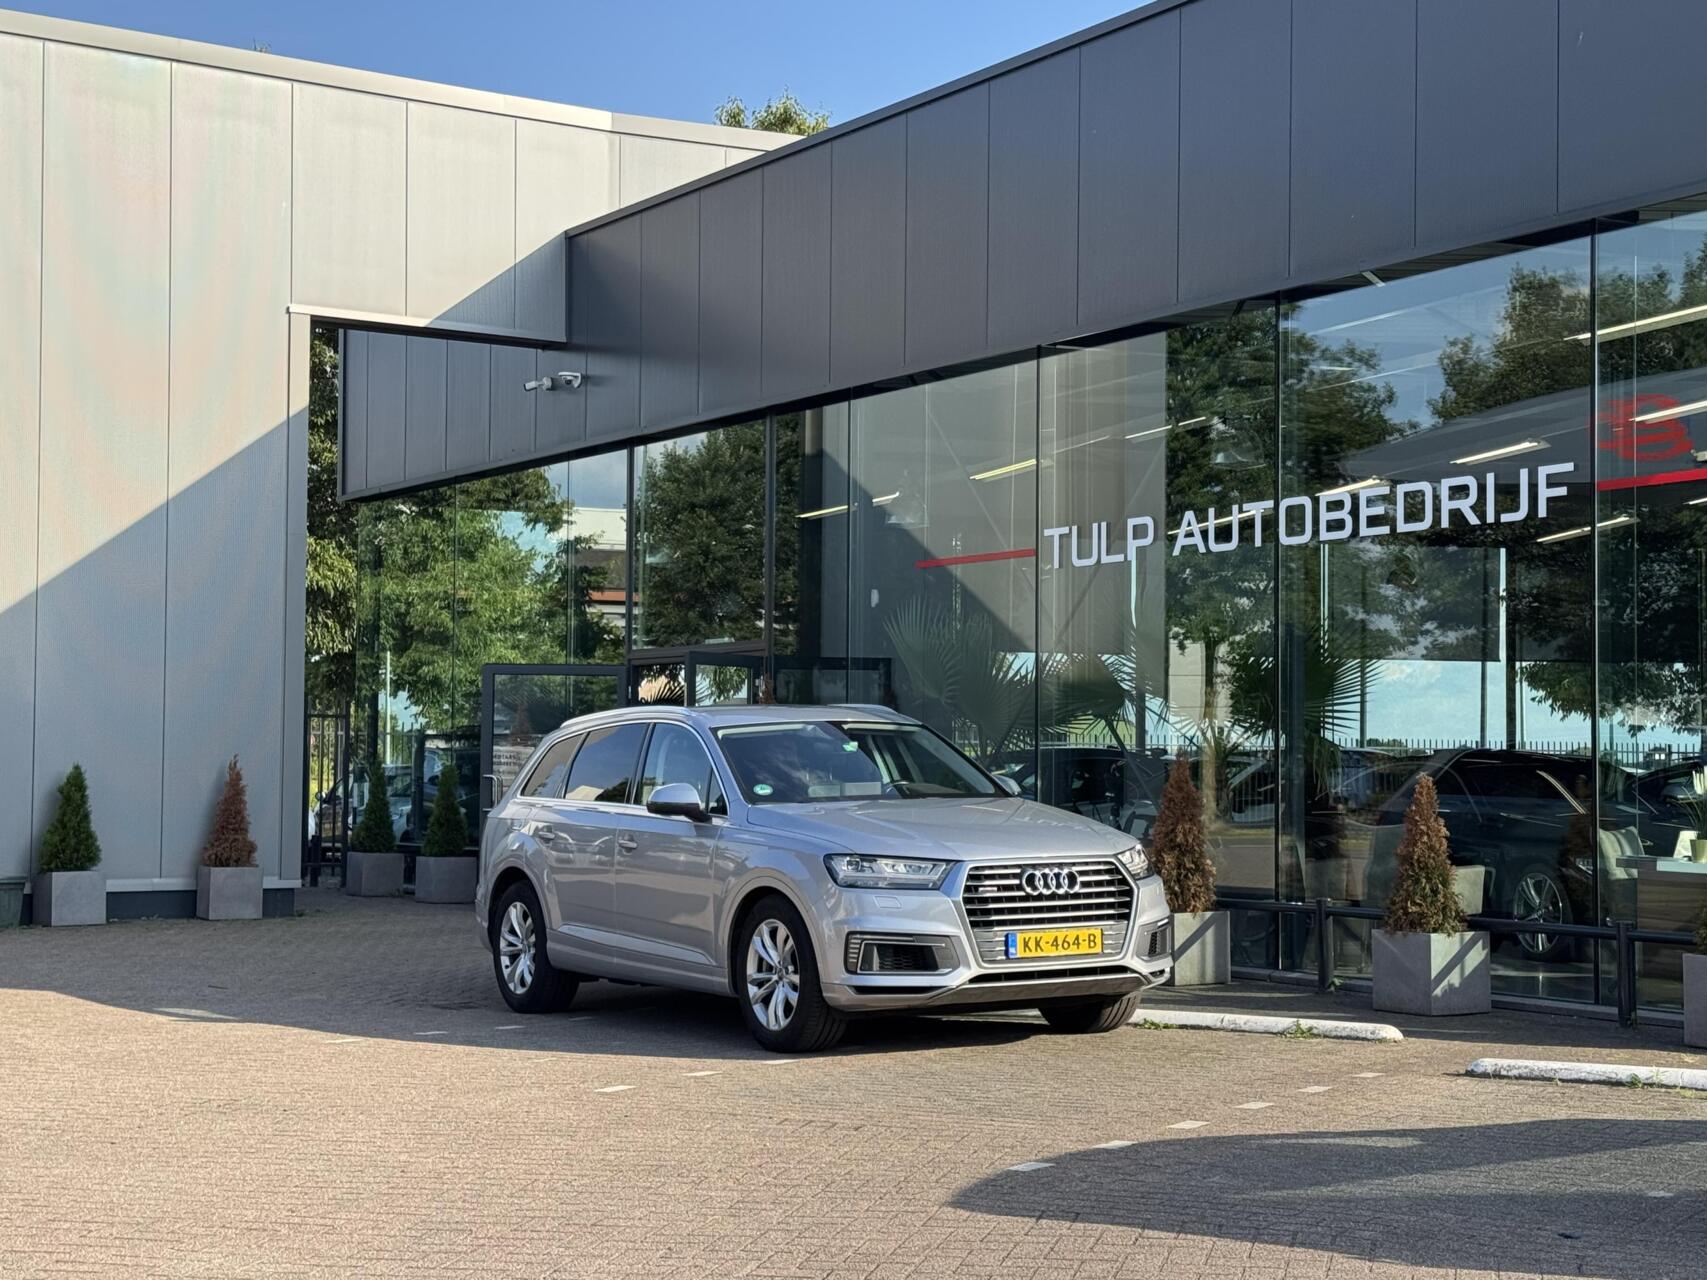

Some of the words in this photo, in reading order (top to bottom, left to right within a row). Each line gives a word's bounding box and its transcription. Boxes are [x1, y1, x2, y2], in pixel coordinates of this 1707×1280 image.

[1043, 516, 1155, 569] TULP
[1172, 462, 1575, 556] AUTOBEDRIJF
[1022, 933, 1098, 954] KK-464-B
